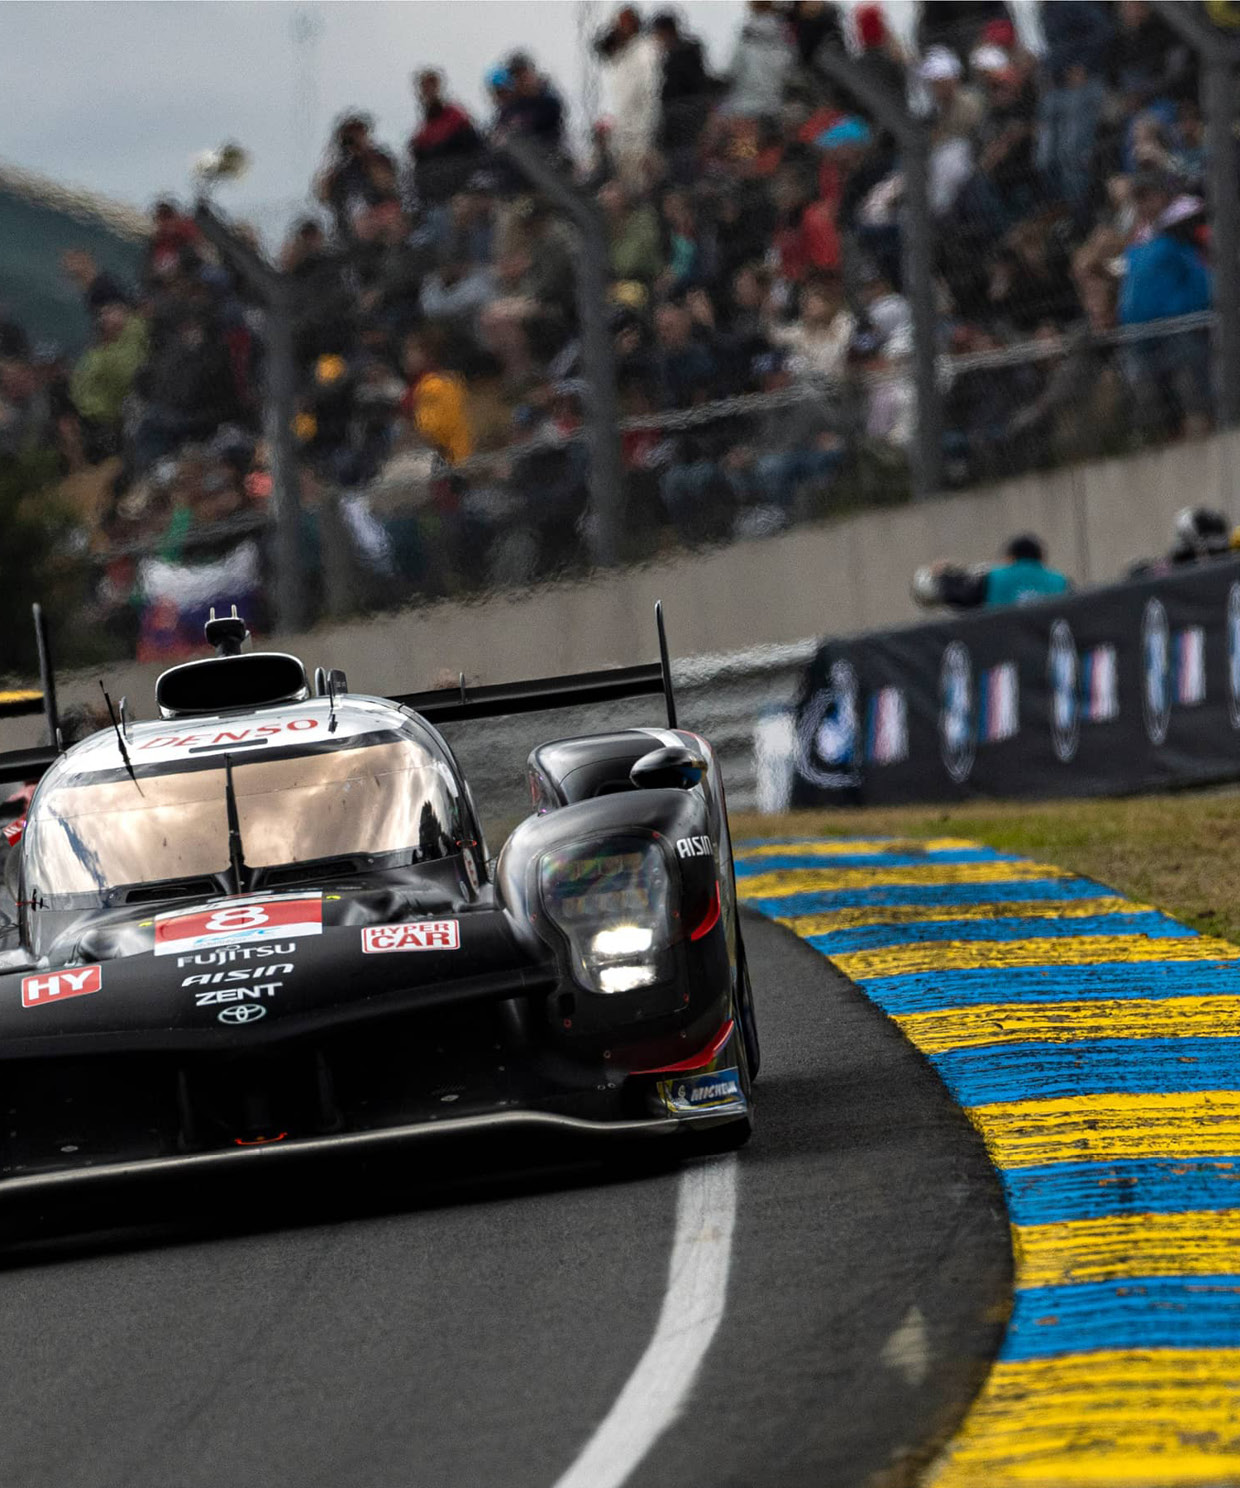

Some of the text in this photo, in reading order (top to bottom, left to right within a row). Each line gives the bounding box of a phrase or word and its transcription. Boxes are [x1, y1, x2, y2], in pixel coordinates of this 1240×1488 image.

[138, 718, 319, 750] DENSO
[676, 835, 714, 859] AISIN
[205, 906, 270, 931] 8
[365, 922, 450, 939] HYPER
[370, 931, 451, 950] CAR
[177, 942, 297, 968] FUJITSU
[28, 969, 94, 1001] HY
[181, 963, 295, 987] AISIN
[195, 982, 283, 1006] ZENT
